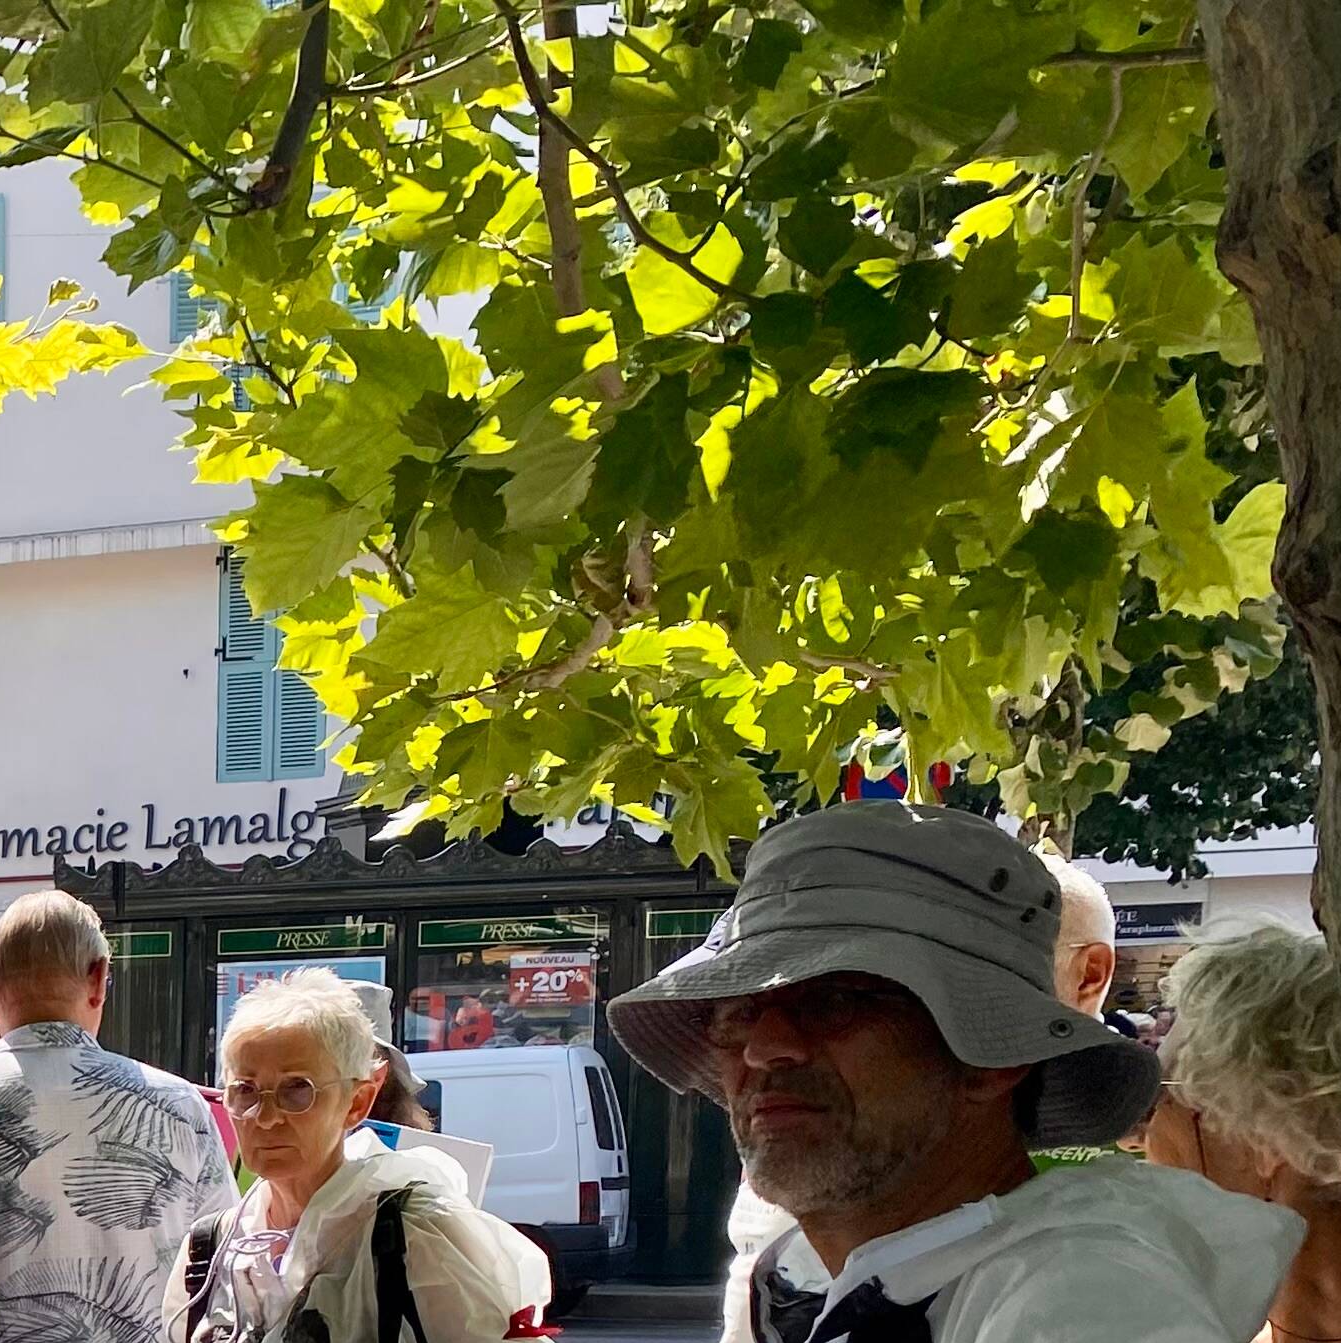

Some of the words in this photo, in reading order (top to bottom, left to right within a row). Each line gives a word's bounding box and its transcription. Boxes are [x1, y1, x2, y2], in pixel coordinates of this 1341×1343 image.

[142, 786, 329, 860] Lamalg
[276, 930, 331, 951] PRESSE
[479, 922, 539, 941] PRESSE
[525, 956, 575, 964] NOUVEAU
